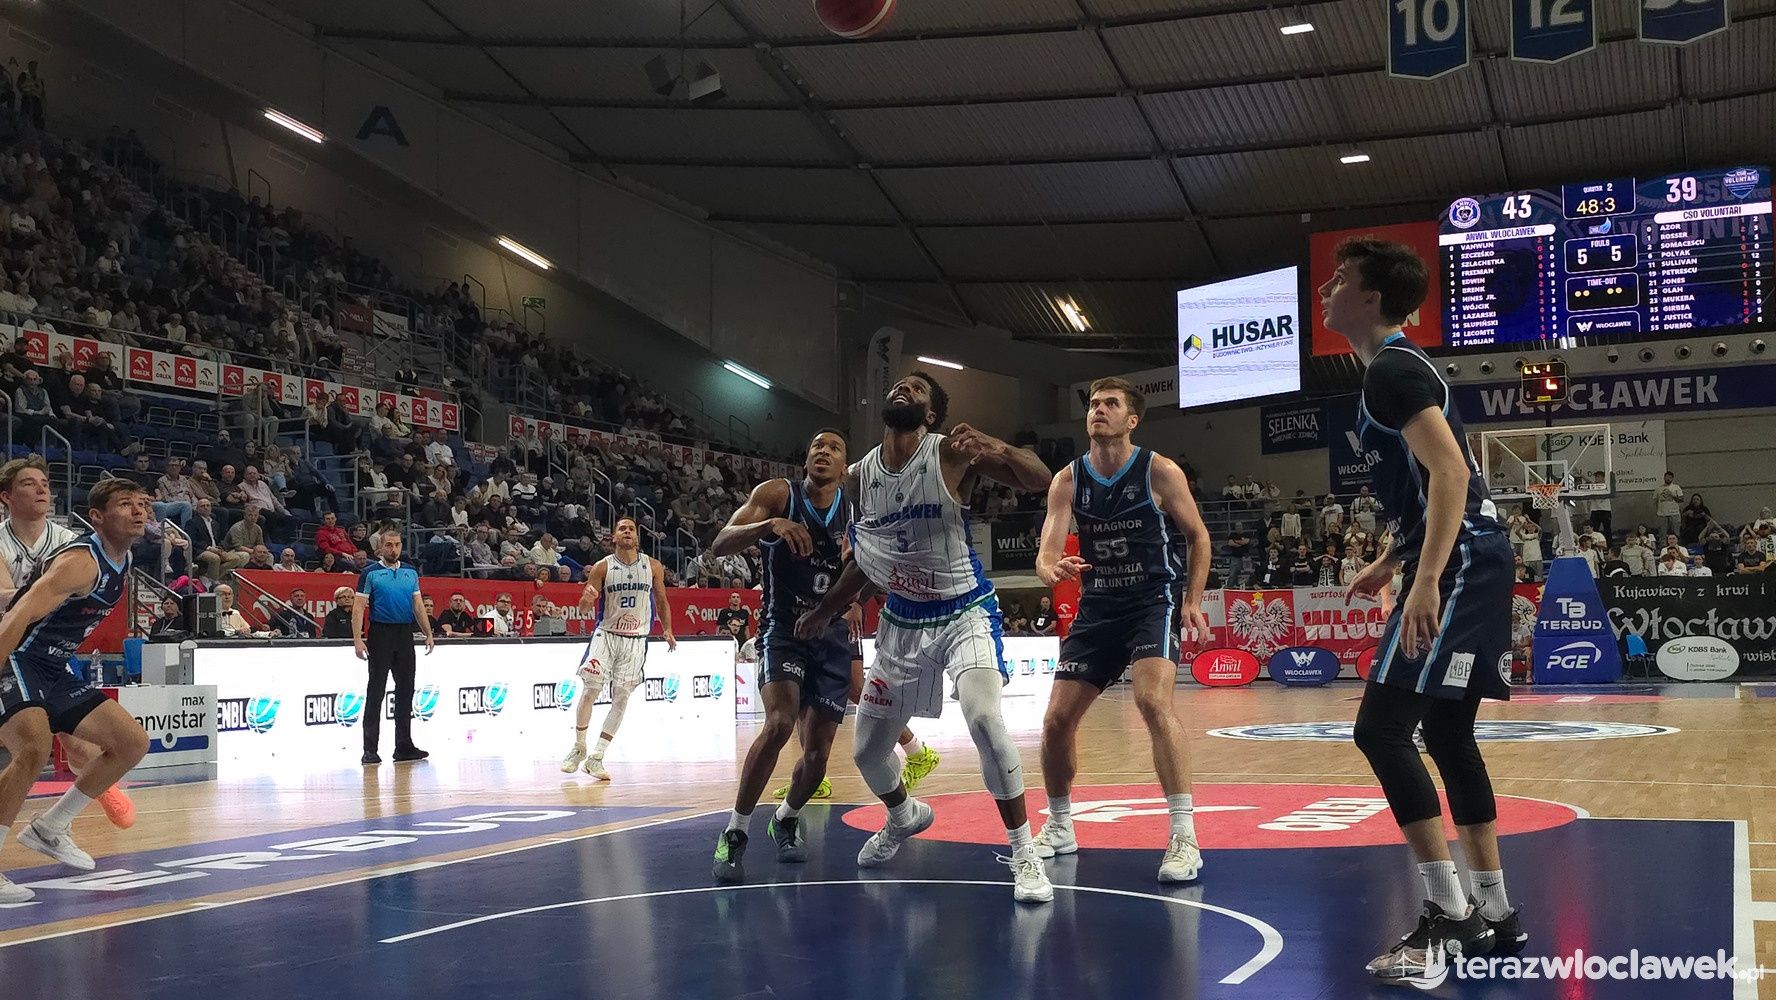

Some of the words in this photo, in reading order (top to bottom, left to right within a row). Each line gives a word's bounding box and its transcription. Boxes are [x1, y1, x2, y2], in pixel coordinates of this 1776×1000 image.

[1395, 0, 1461, 46] 10
[1606, 183, 1613, 192] 2
[1666, 176, 1697, 203] 39
[1502, 194, 1532, 220] 43
[1683, 210, 1698, 220] CSO
[1700, 206, 1742, 218] VOLUNTARI
[1660, 223, 1681, 231] AZOR
[1466, 231, 1488, 242] ANWIL
[1590, 239, 1610, 248] FOULS
[1660, 239, 1705, 249] SOMACESCU
[1577, 248, 1588, 265] 5
[1611, 245, 1622, 262] 5
[1661, 249, 1691, 258] POLYAK
[1661, 258, 1698, 267] SULLIVAN
[1661, 267, 1698, 276] PETRESCU
[1462, 277, 1485, 285] EDWIN
[1587, 276, 1618, 287] TIME-OUT
[1661, 276, 1686, 285] JONES
[1663, 312, 1693, 321] JUSTICE
[1212, 315, 1293, 349] HUSAR
[1663, 322, 1693, 330] DURMO
[1463, 329, 1495, 337] LECOMTE
[26, 351, 46, 360] ORLEN
[132, 368, 151, 377] ORLEN
[155, 372, 172, 380] ORLEN
[177, 376, 194, 384] ORLEN
[199, 379, 214, 387] ORLEN
[1480, 375, 1719, 416] WŁCŁAWEK
[1269, 414, 1320, 437] SELENKA
[1619, 432, 1649, 444] Bank
[1337, 464, 1370, 475] WŁOCŁ
[1093, 520, 1143, 533] MAGNOR
[1093, 537, 1130, 559] 55
[813, 572, 831, 594] 0
[1613, 584, 1686, 599] Kujawiacy
[1697, 588, 1704, 597] z
[1716, 584, 1749, 596] krwi
[1761, 583, 1765, 595] i
[620, 596, 636, 608] 20
[307, 600, 337, 617] LEN
[701, 608, 719, 621] ORL
[1302, 607, 1387, 641] WŁOC
[1540, 620, 1603, 630] TERBUD
[1209, 657, 1241, 672] Anwil
[1546, 654, 1590, 670] PGE
[181, 696, 205, 706] max
[460, 689, 484, 713] ENBL
[863, 694, 893, 707] ORLEN
[306, 697, 334, 723] ENBL
[0, 809, 577, 906] ERBUD
